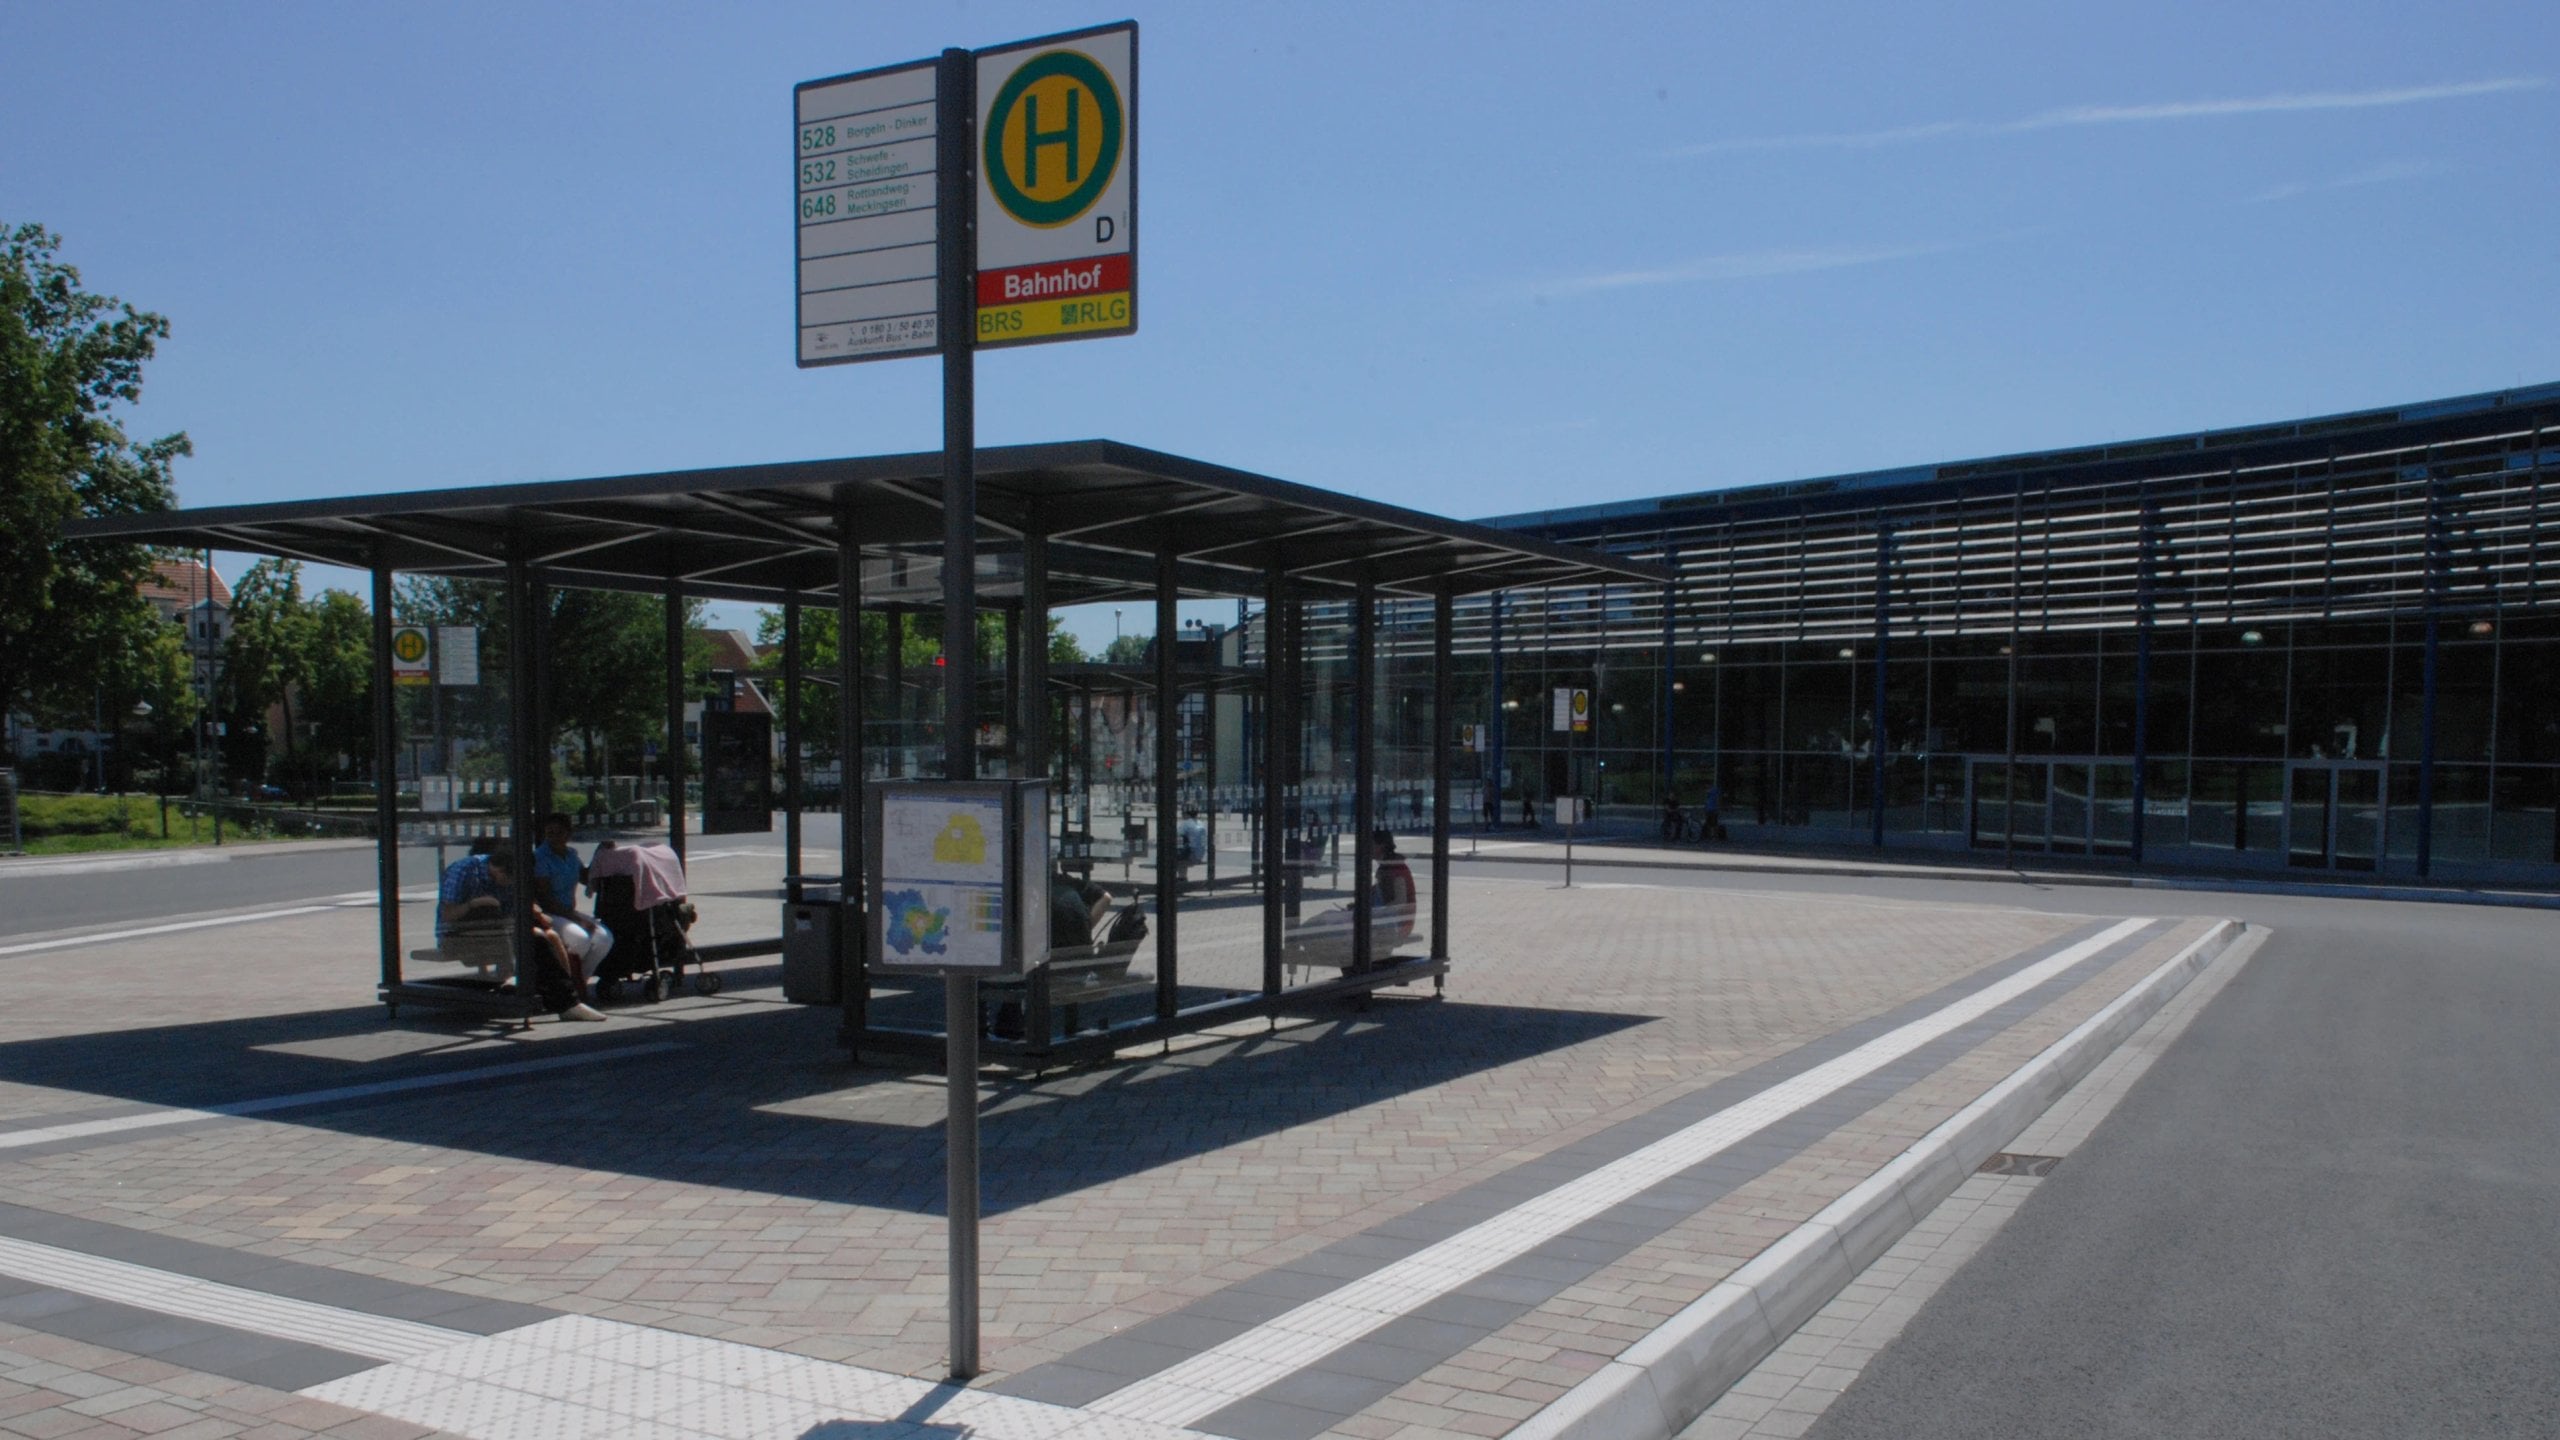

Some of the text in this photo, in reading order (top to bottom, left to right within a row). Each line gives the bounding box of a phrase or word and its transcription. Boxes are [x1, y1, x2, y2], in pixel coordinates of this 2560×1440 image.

[803, 125, 836, 150] 528
[847, 123, 886, 138] Borgeln
[895, 116, 928, 130] Dinker
[1025, 88, 1079, 189] H
[847, 151, 888, 166] Schwefe
[847, 162, 909, 180] Scheidingen
[803, 160, 836, 184] 532
[803, 194, 836, 218] 648
[847, 198, 906, 214] Meckingsen
[1096, 216, 1115, 243] D
[1004, 264, 1102, 298] Bahnhof
[979, 309, 1024, 334] BRS
[1081, 298, 1126, 323] RLG
